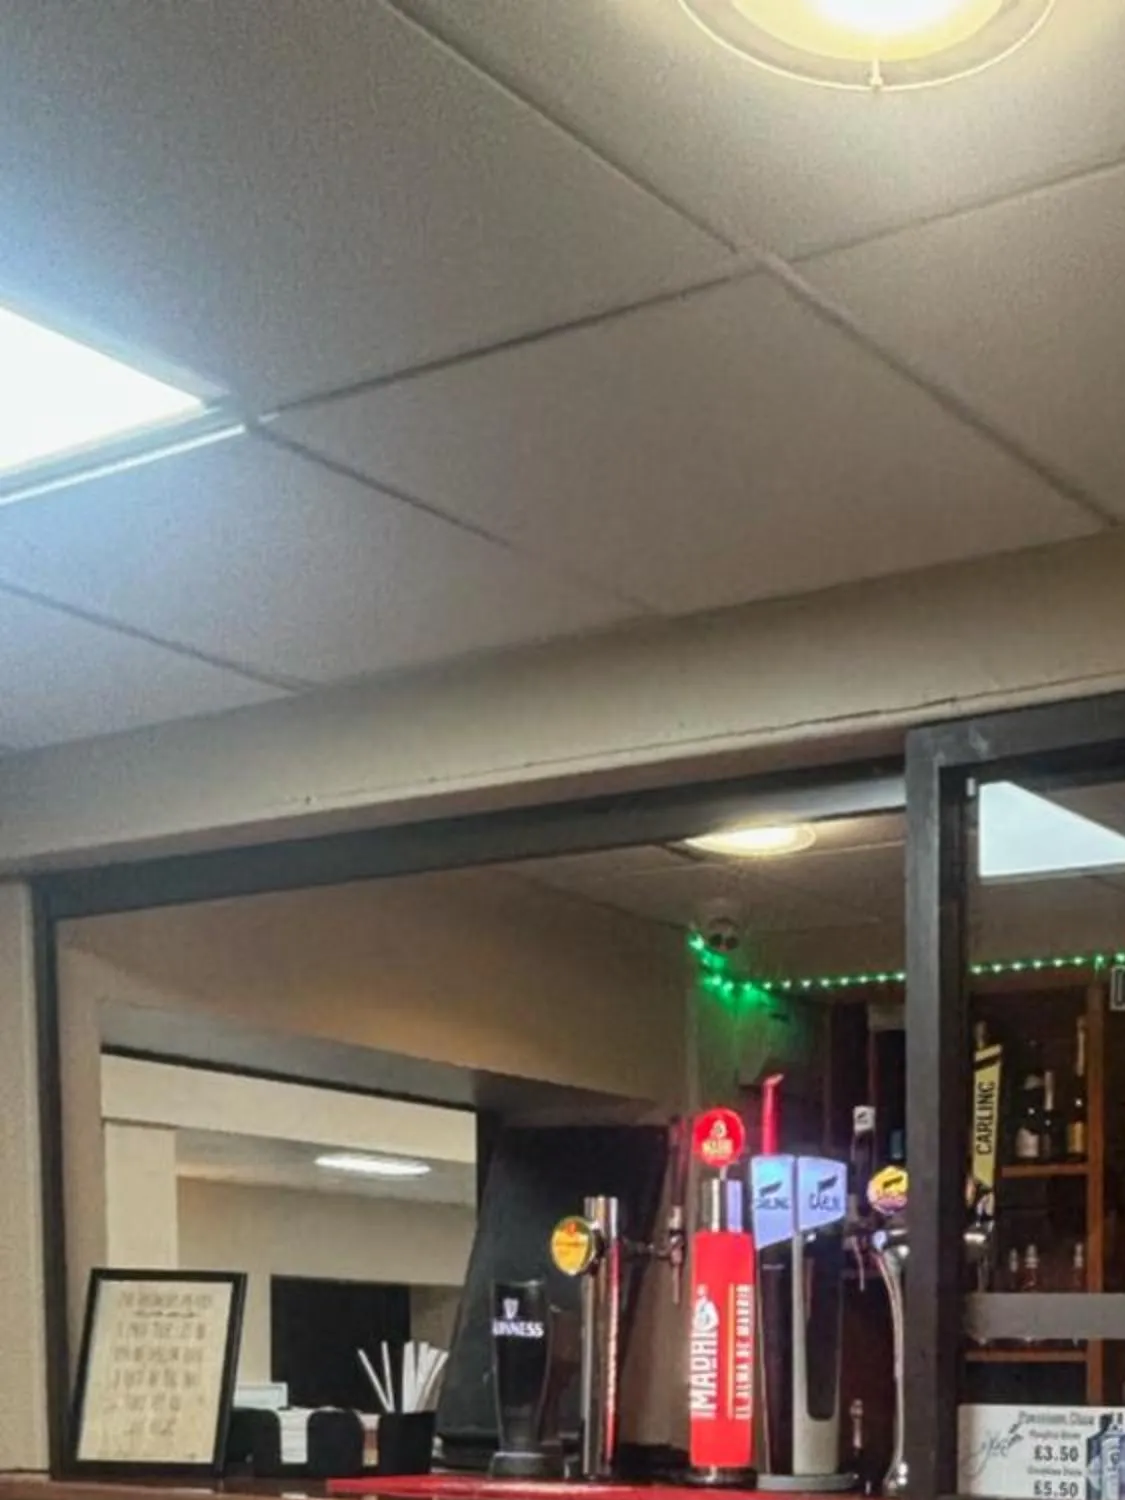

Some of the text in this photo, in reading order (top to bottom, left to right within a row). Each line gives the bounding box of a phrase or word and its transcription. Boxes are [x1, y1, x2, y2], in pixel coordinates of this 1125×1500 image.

[976, 1081, 996, 1155] CARLING
[1033, 1444, 1080, 1463] £3.50
[1033, 1480, 1080, 1499] £5.50
